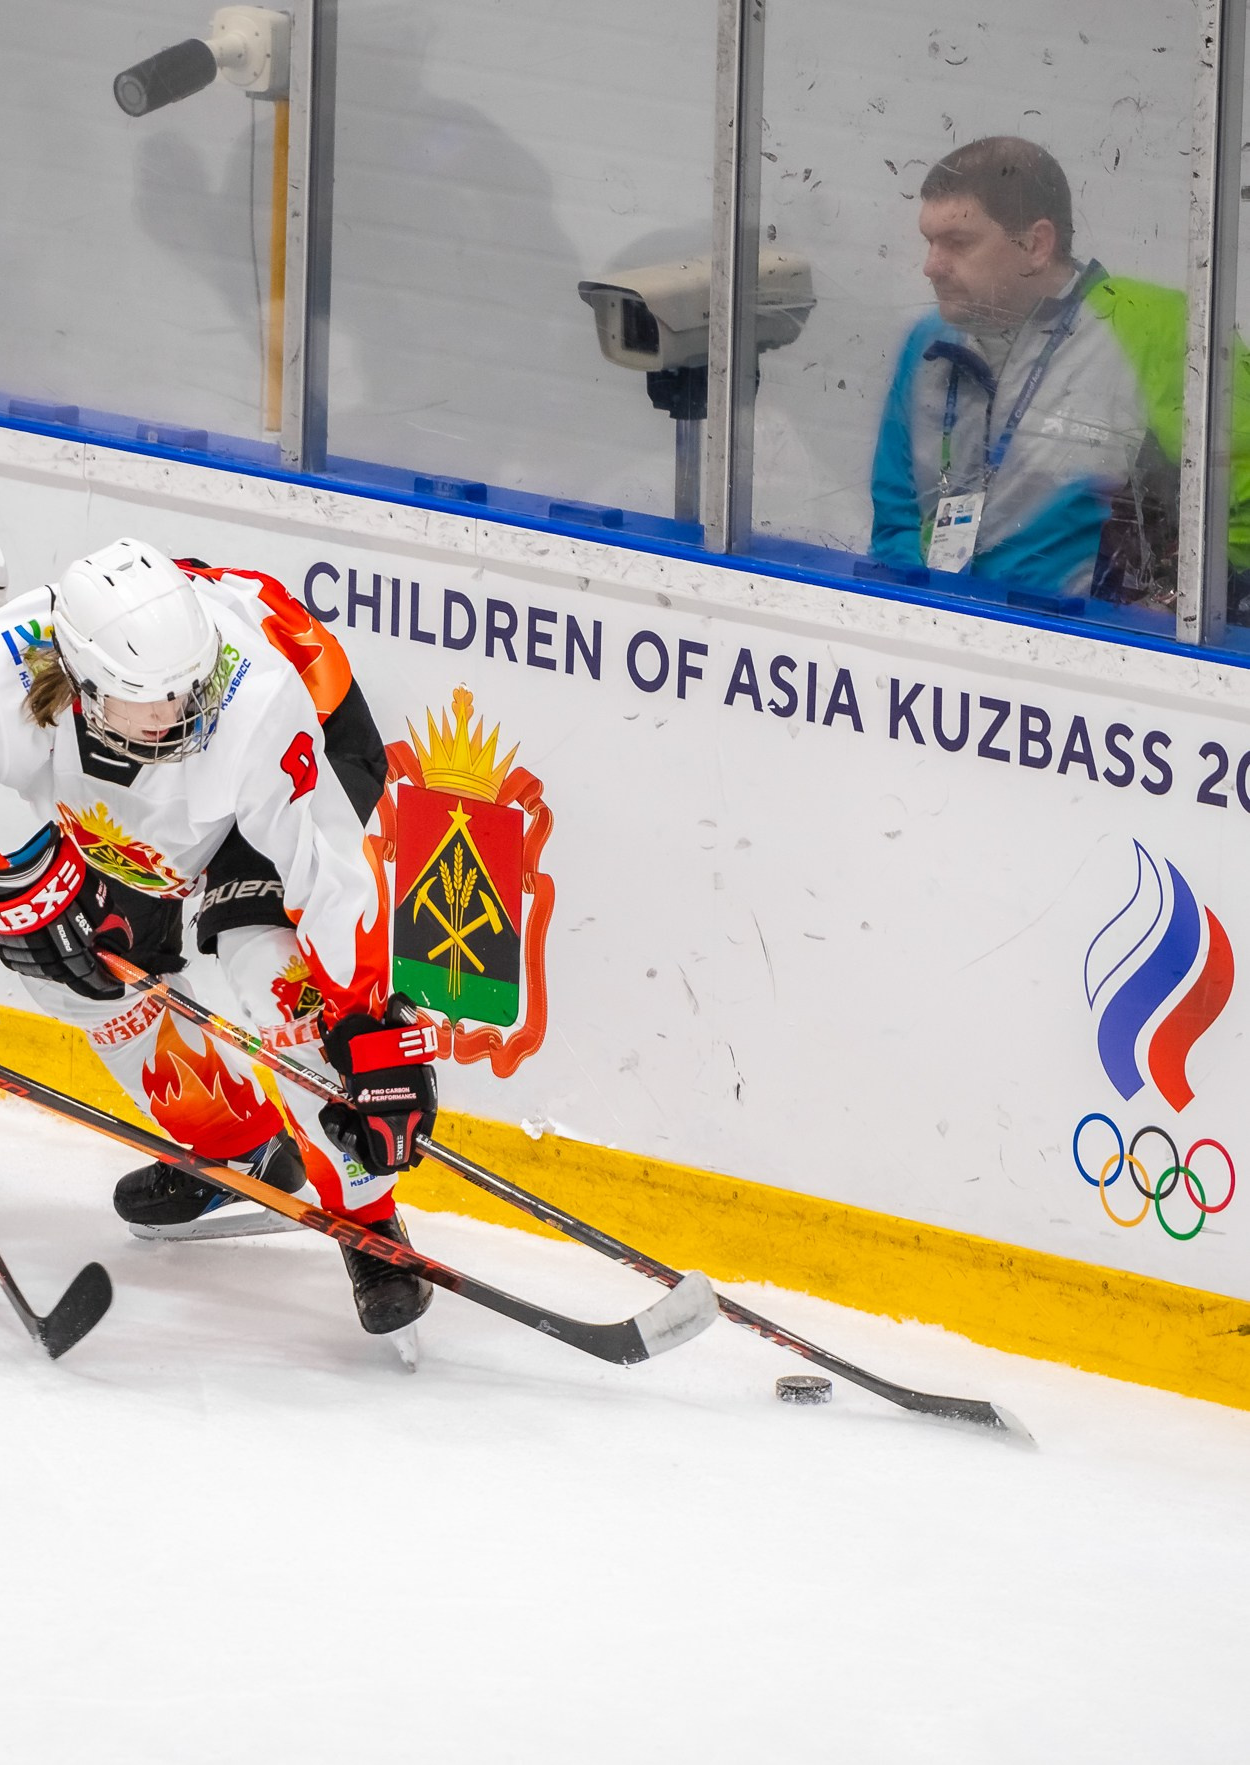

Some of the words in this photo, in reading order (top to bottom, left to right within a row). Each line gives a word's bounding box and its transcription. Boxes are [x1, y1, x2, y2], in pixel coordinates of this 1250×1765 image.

[303, 561, 603, 681] CHILDREN
[626, 630, 709, 700] OF
[723, 647, 865, 734] ASIA
[889, 677, 1174, 796] KUZBASS
[196, 878, 285, 922] AUER
[371, 1092, 417, 1101] PERFORMANCE
[385, 1086, 410, 1095] CARBON
